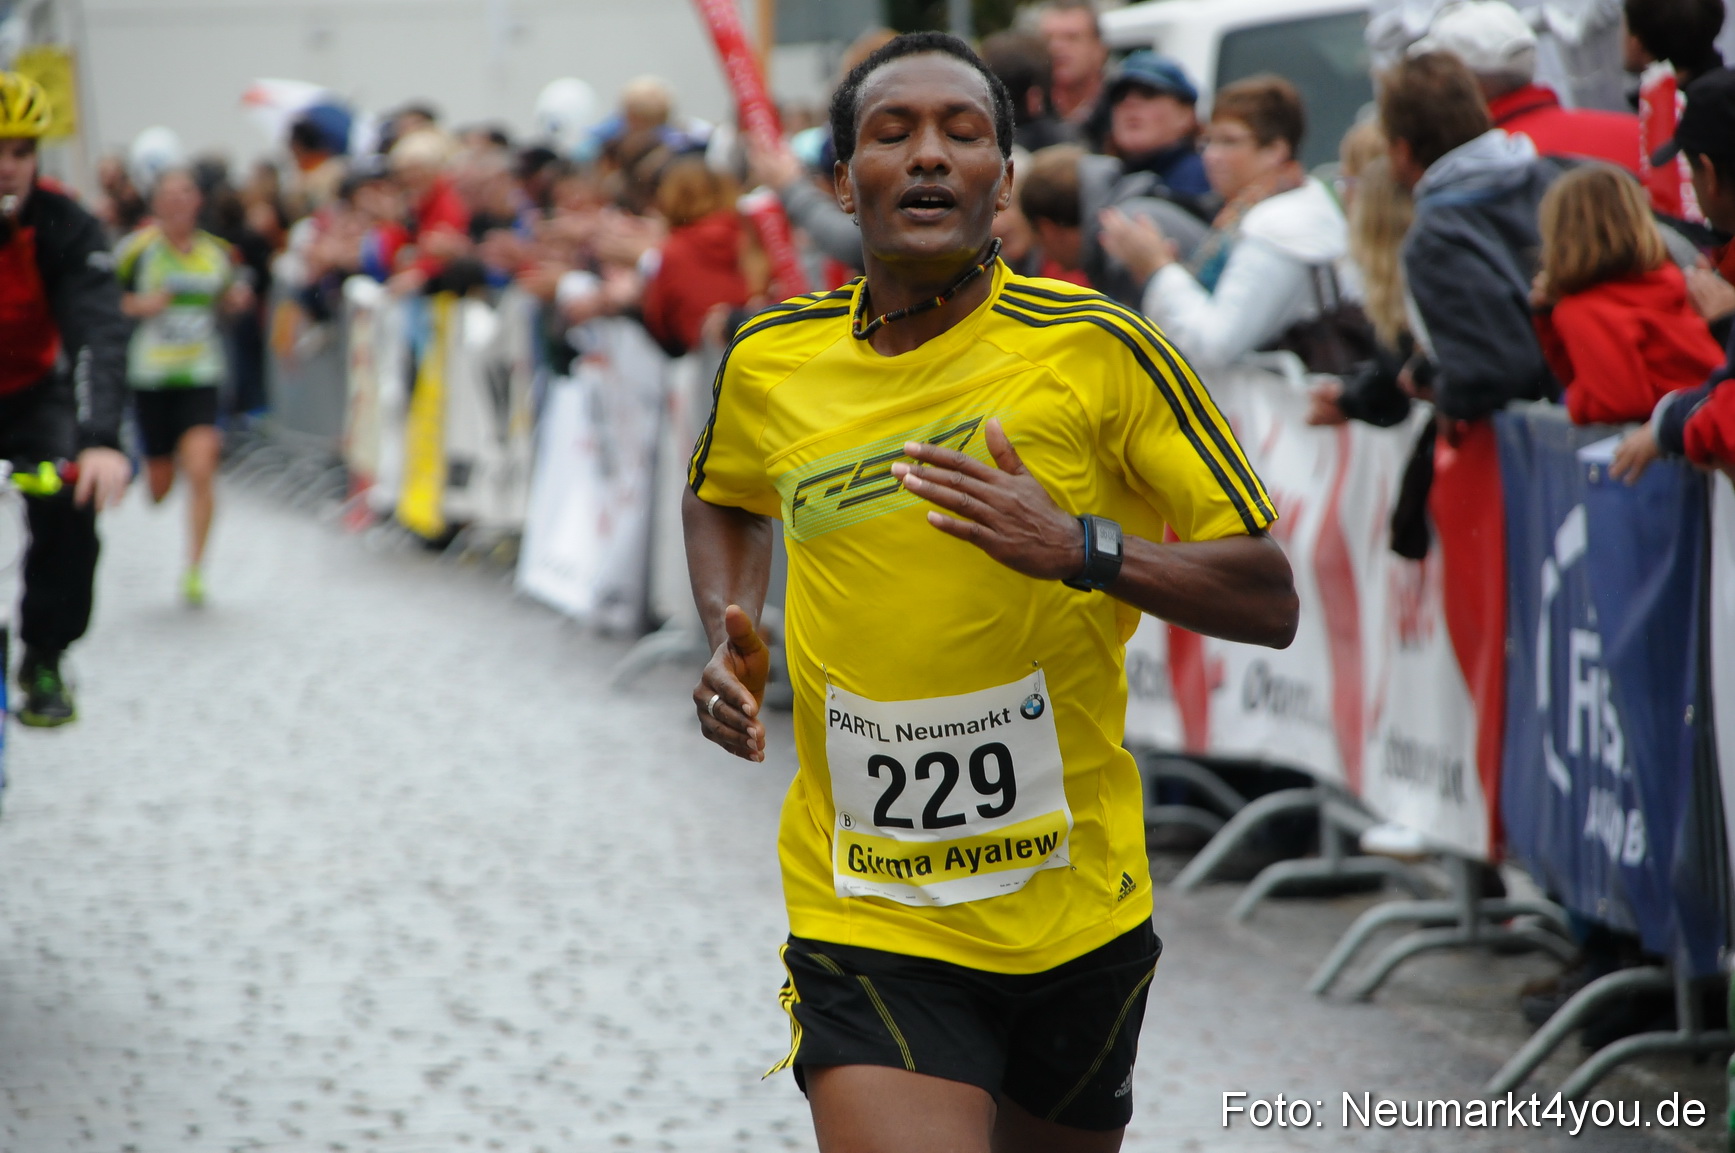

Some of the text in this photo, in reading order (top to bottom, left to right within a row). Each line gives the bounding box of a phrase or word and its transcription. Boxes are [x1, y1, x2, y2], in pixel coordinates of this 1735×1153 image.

[828, 707, 1012, 743] PARTL Neumarkt
[866, 741, 1018, 830] 229
[847, 830, 1059, 879] Girma Ayalew
